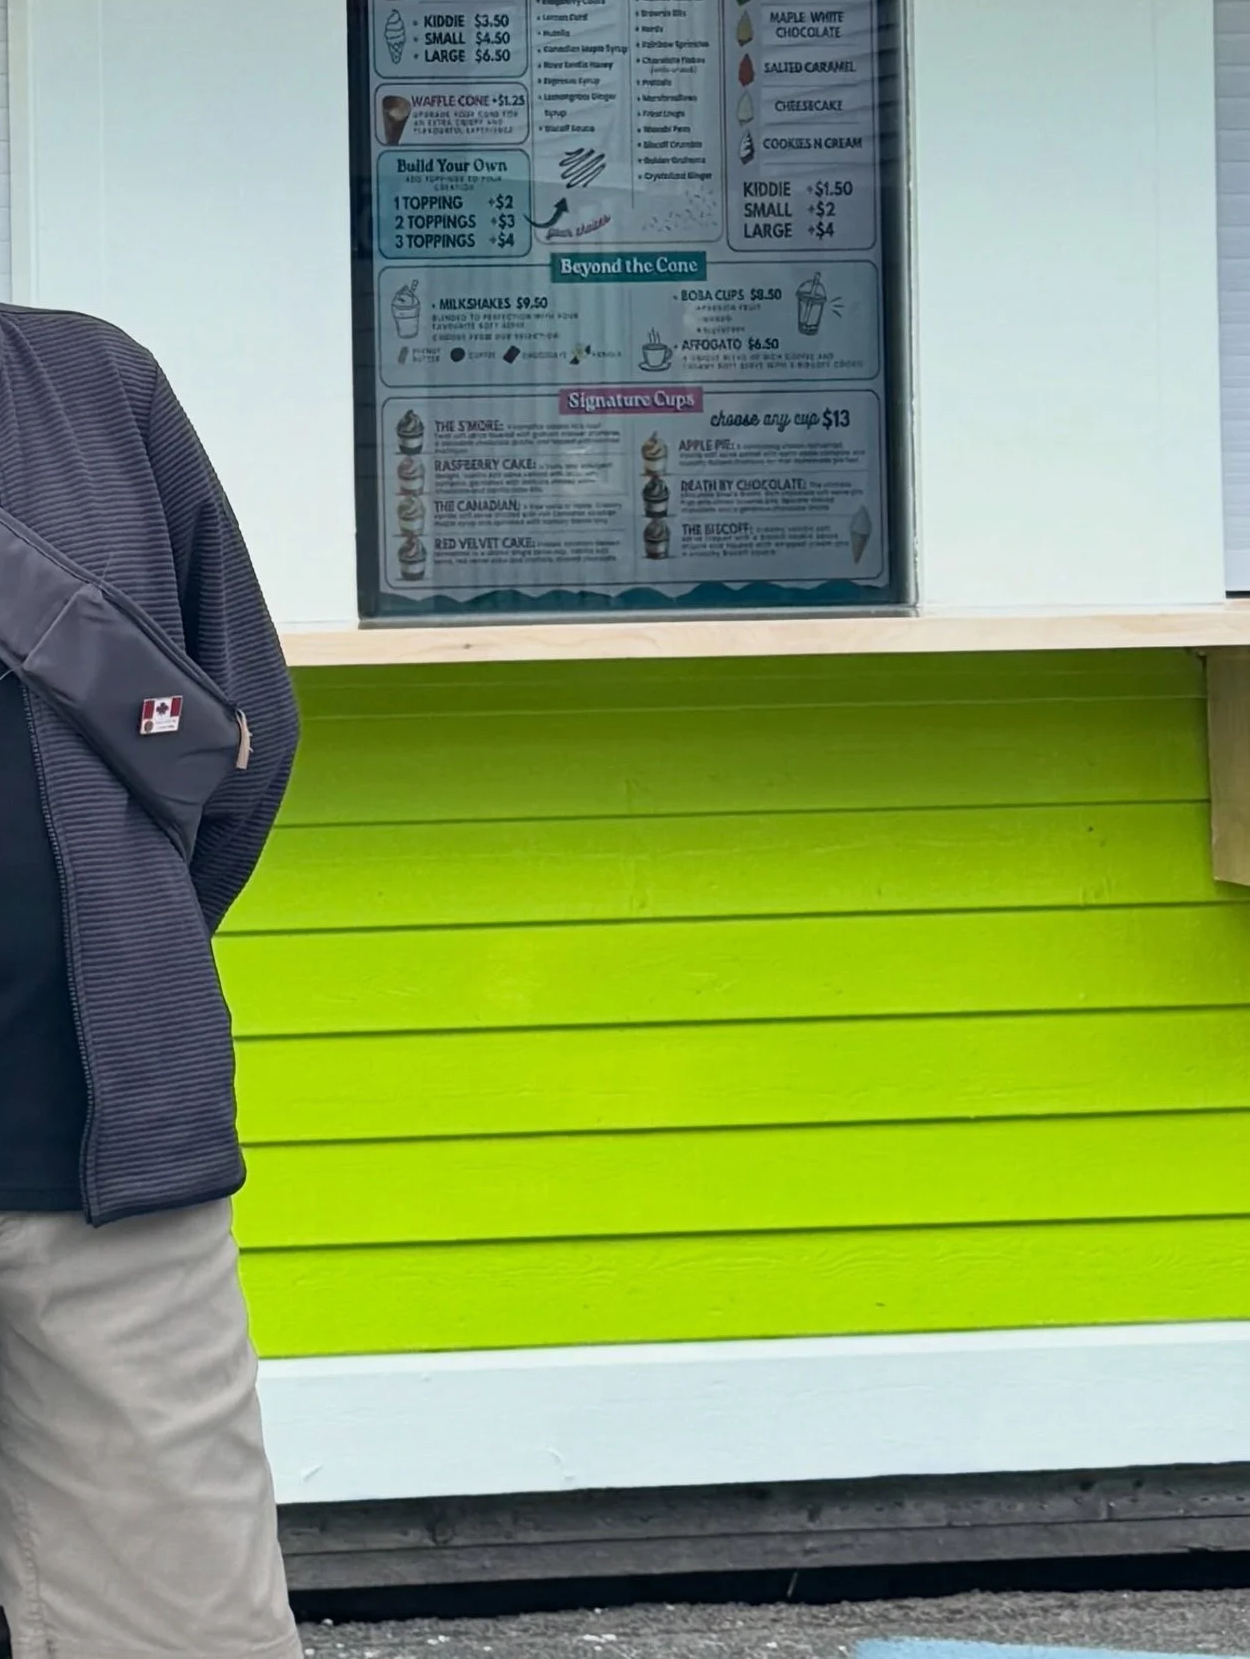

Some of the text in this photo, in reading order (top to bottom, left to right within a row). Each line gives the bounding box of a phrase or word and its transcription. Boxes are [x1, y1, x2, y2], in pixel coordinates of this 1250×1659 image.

[424, 13, 510, 29] KIDDIE $3.50
[770, 11, 844, 23] MAPLE WHITE
[425, 31, 511, 47] SMALL $4.50
[776, 27, 843, 39] CHOCOLATE
[424, 49, 511, 64] LARGE $6.50
[764, 61, 856, 73] SALTED CARAMEL
[412, 95, 455, 107] WAFFLE
[457, 95, 490, 107] CONE
[774, 101, 843, 112] CHEESECAKE
[763, 138, 811, 149] COOKIES
[824, 138, 862, 149] CREAM
[397, 158, 508, 173] Build Your Own
[743, 181, 792, 197] KIDDIE
[394, 197, 400, 210] 1
[403, 197, 464, 210] TOPPING
[744, 202, 792, 218] SMALL
[395, 215, 404, 229] 2
[407, 215, 477, 229] TOPPINGS
[744, 223, 793, 239] LARGE
[395, 235, 404, 249] 3
[406, 233, 476, 249] TOPPINGS
[560, 257, 698, 277] Beyond the Cone
[681, 288, 782, 301] BOBA CUPS $8.50
[440, 296, 548, 311] MILKSHAKES $9.50
[682, 337, 780, 351] AFFOGATO $6.50
[569, 390, 695, 412] Signature Cups
[435, 420, 455, 432] THE
[710, 407, 850, 433] choose any cup $13
[679, 439, 714, 451] APPLE
[434, 459, 500, 472] RASPBERRY
[502, 457, 536, 470] CAKE:
[681, 479, 716, 492] DEATH
[720, 479, 733, 491] BY
[736, 478, 806, 491] CHOCOLATE:
[434, 500, 455, 512] THE
[682, 523, 702, 535] THE
[435, 537, 457, 550] RED
[460, 537, 500, 549] VELVET
[502, 537, 536, 549] CAKE:
